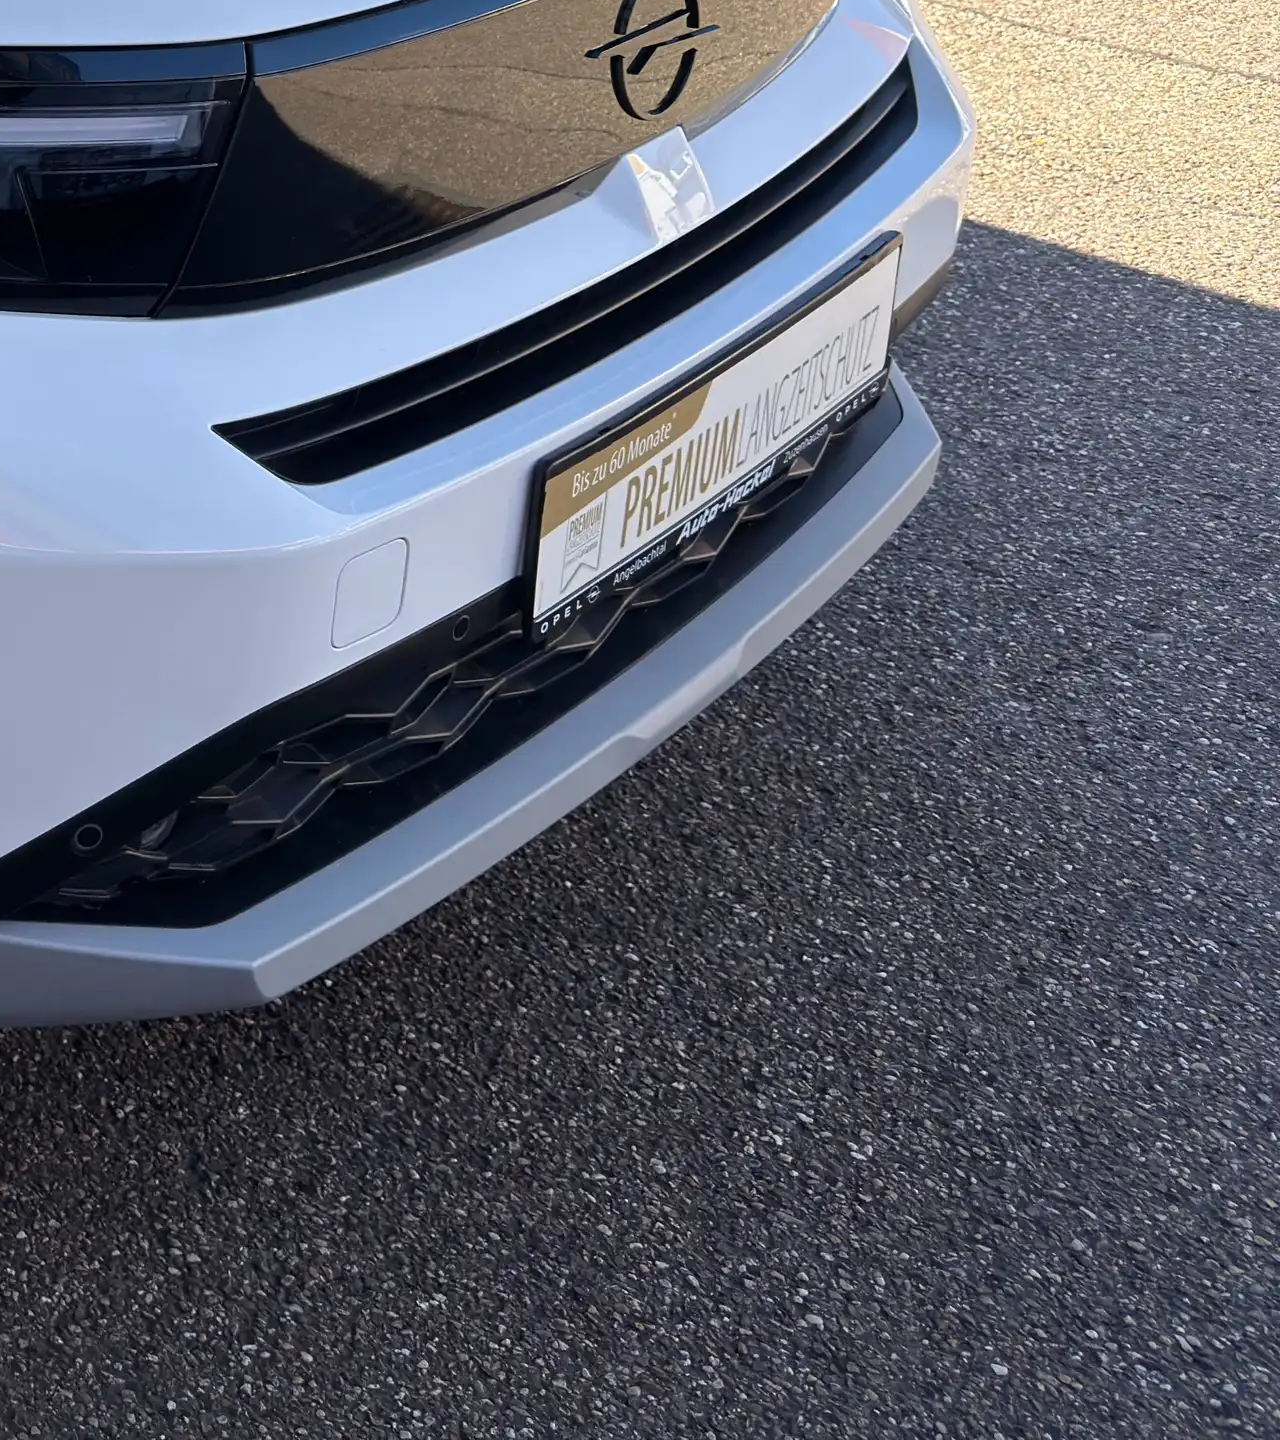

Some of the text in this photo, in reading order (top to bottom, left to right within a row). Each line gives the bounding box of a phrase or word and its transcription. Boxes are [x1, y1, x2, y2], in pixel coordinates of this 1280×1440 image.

[540, 598, 583, 634] OPEL
[612, 543, 668, 587] Angelbachtal
[835, 393, 867, 422] OPEL
[572, 470, 590, 498] Bis
[592, 462, 608, 486] zu
[609, 446, 626, 474] 60
